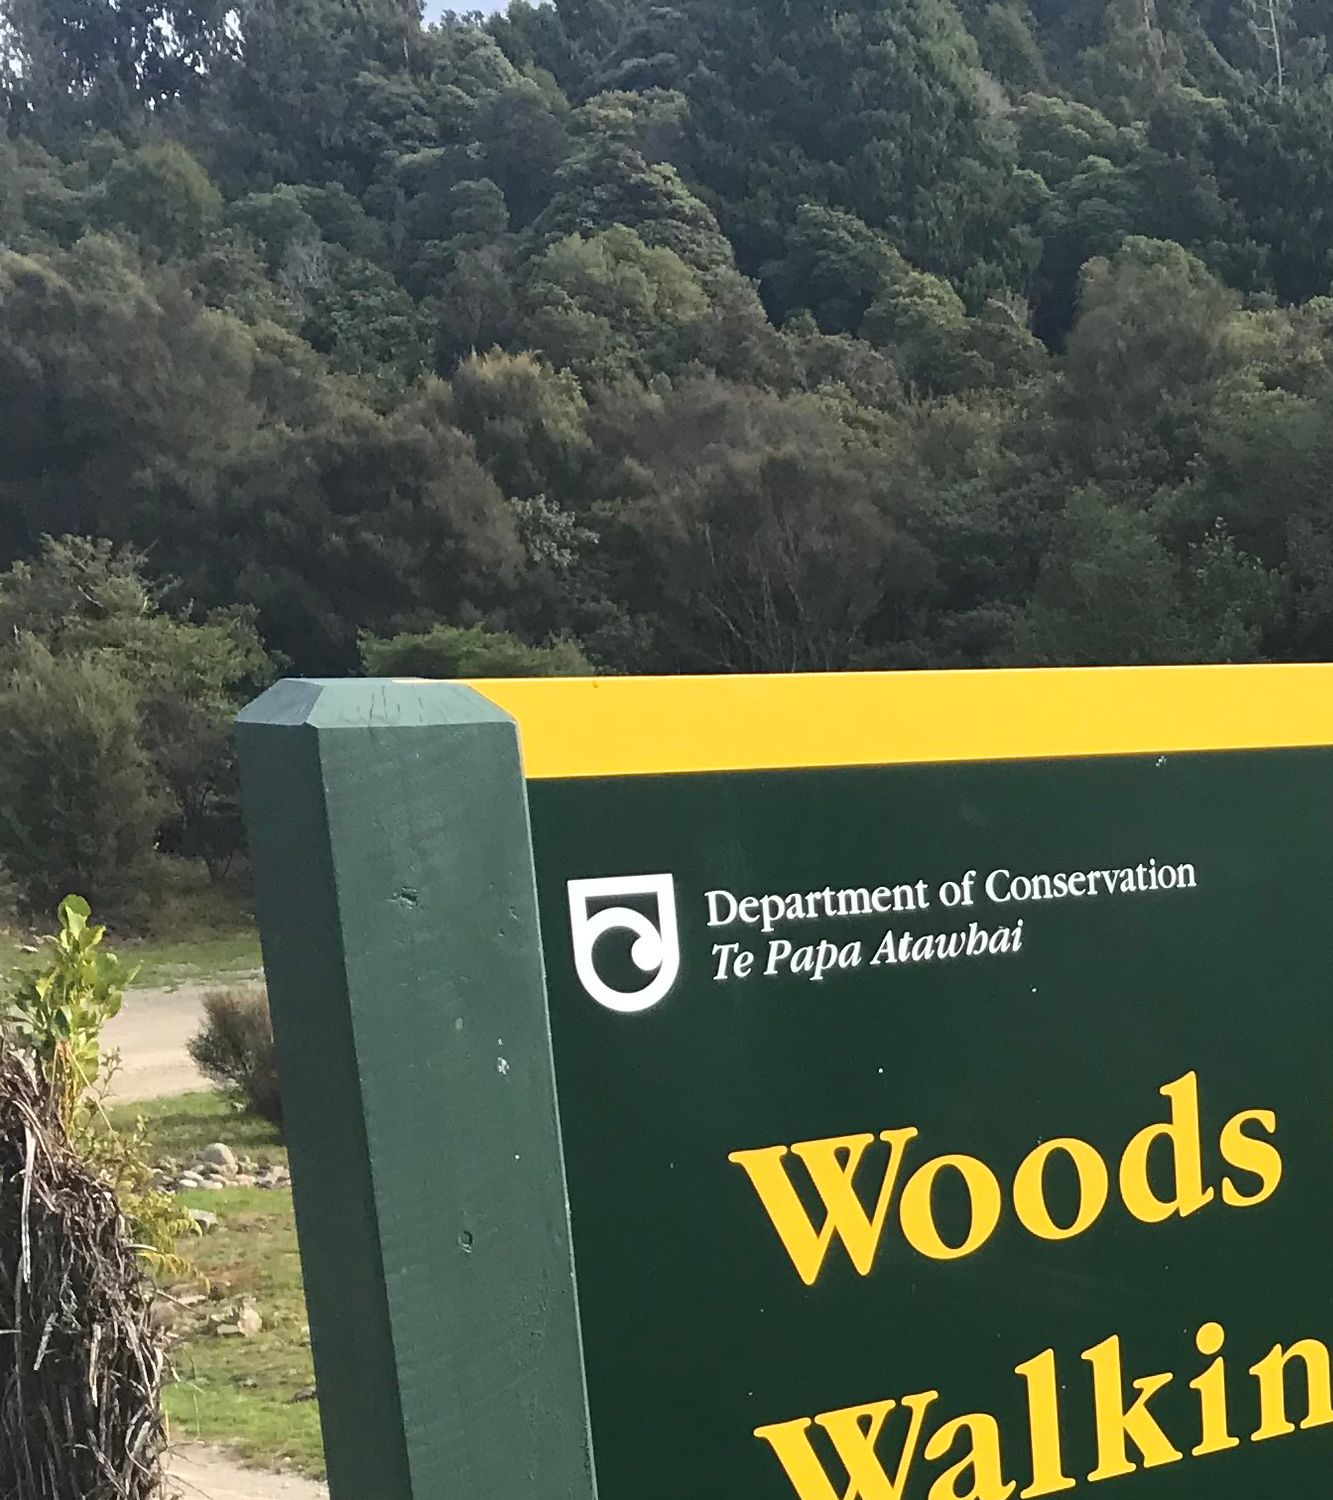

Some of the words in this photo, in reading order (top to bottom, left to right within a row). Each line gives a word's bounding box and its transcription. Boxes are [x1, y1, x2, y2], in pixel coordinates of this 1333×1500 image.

[705, 877, 931, 933] Department
[938, 869, 976, 908] of
[985, 858, 1198, 903] Conservation
[711, 939, 754, 981] Te
[763, 936, 862, 982] Papa
[869, 918, 1025, 967] Atawhai
[728, 1070, 1284, 1286] Woods
